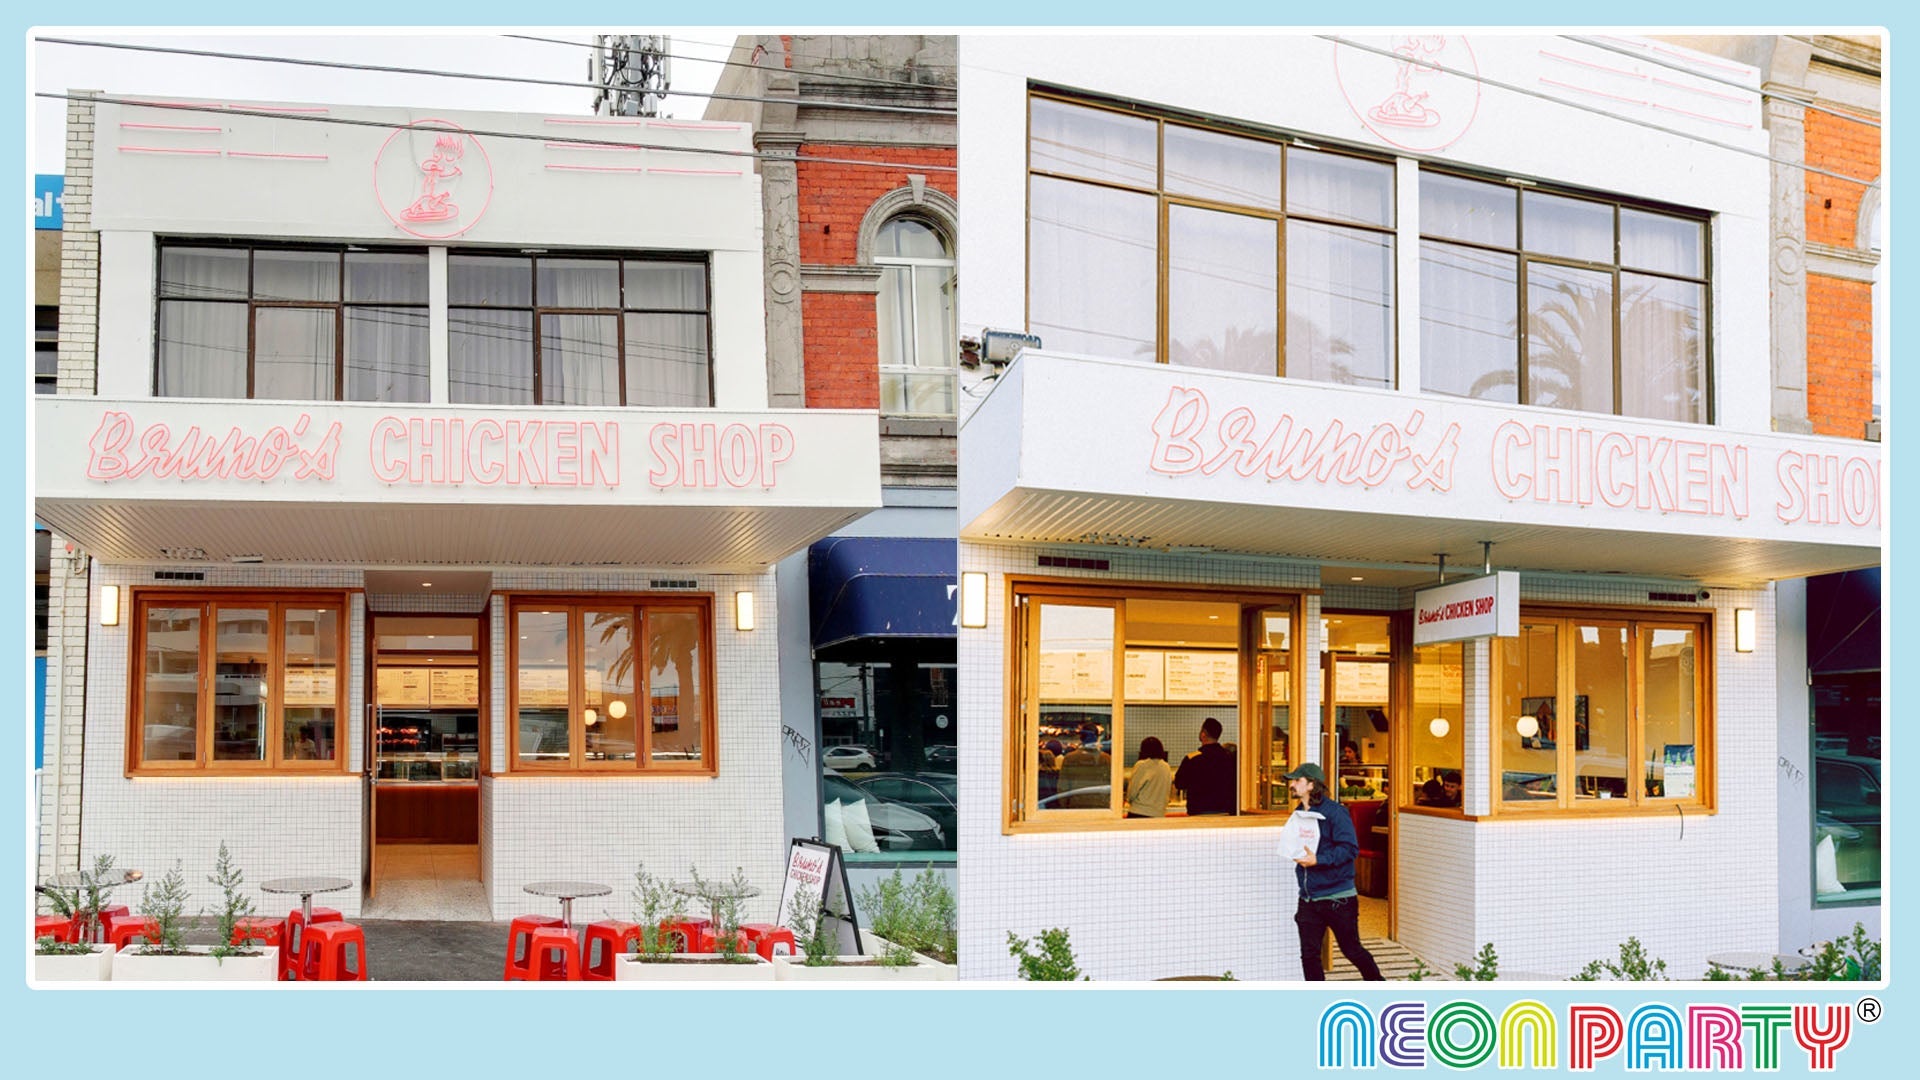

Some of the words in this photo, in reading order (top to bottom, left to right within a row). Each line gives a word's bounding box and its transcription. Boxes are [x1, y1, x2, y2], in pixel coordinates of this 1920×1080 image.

[86, 410, 342, 483] Bruno's
[370, 415, 622, 488] CHICKEN
[648, 421, 796, 490] SHOP
[1147, 384, 1462, 492] Bruno's
[1491, 419, 1751, 519] CHICKEN
[1775, 449, 1881, 528] SHO
[1445, 600, 1474, 620] CHICKEN
[1475, 596, 1494, 615] SHOP
